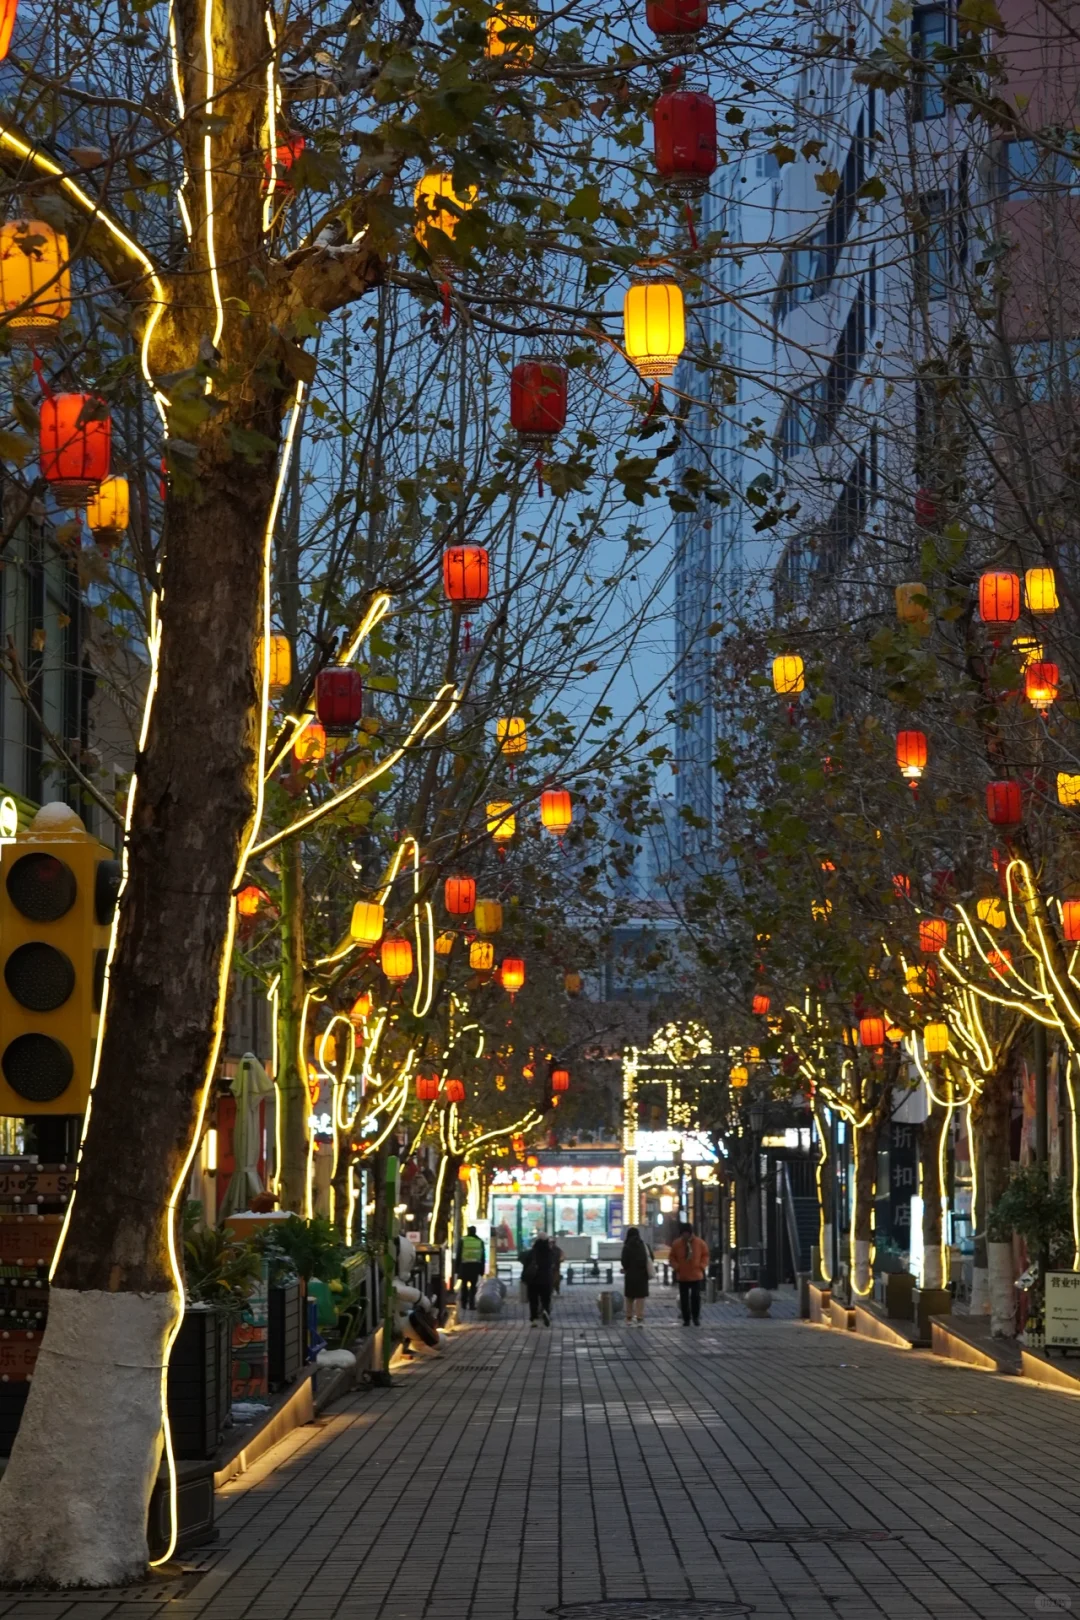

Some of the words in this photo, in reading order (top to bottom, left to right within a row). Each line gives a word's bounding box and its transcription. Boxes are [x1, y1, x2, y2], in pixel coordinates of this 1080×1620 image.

[893, 1126, 913, 1226] 折扣店
[1050, 1277, 1080, 1289] 营业中
